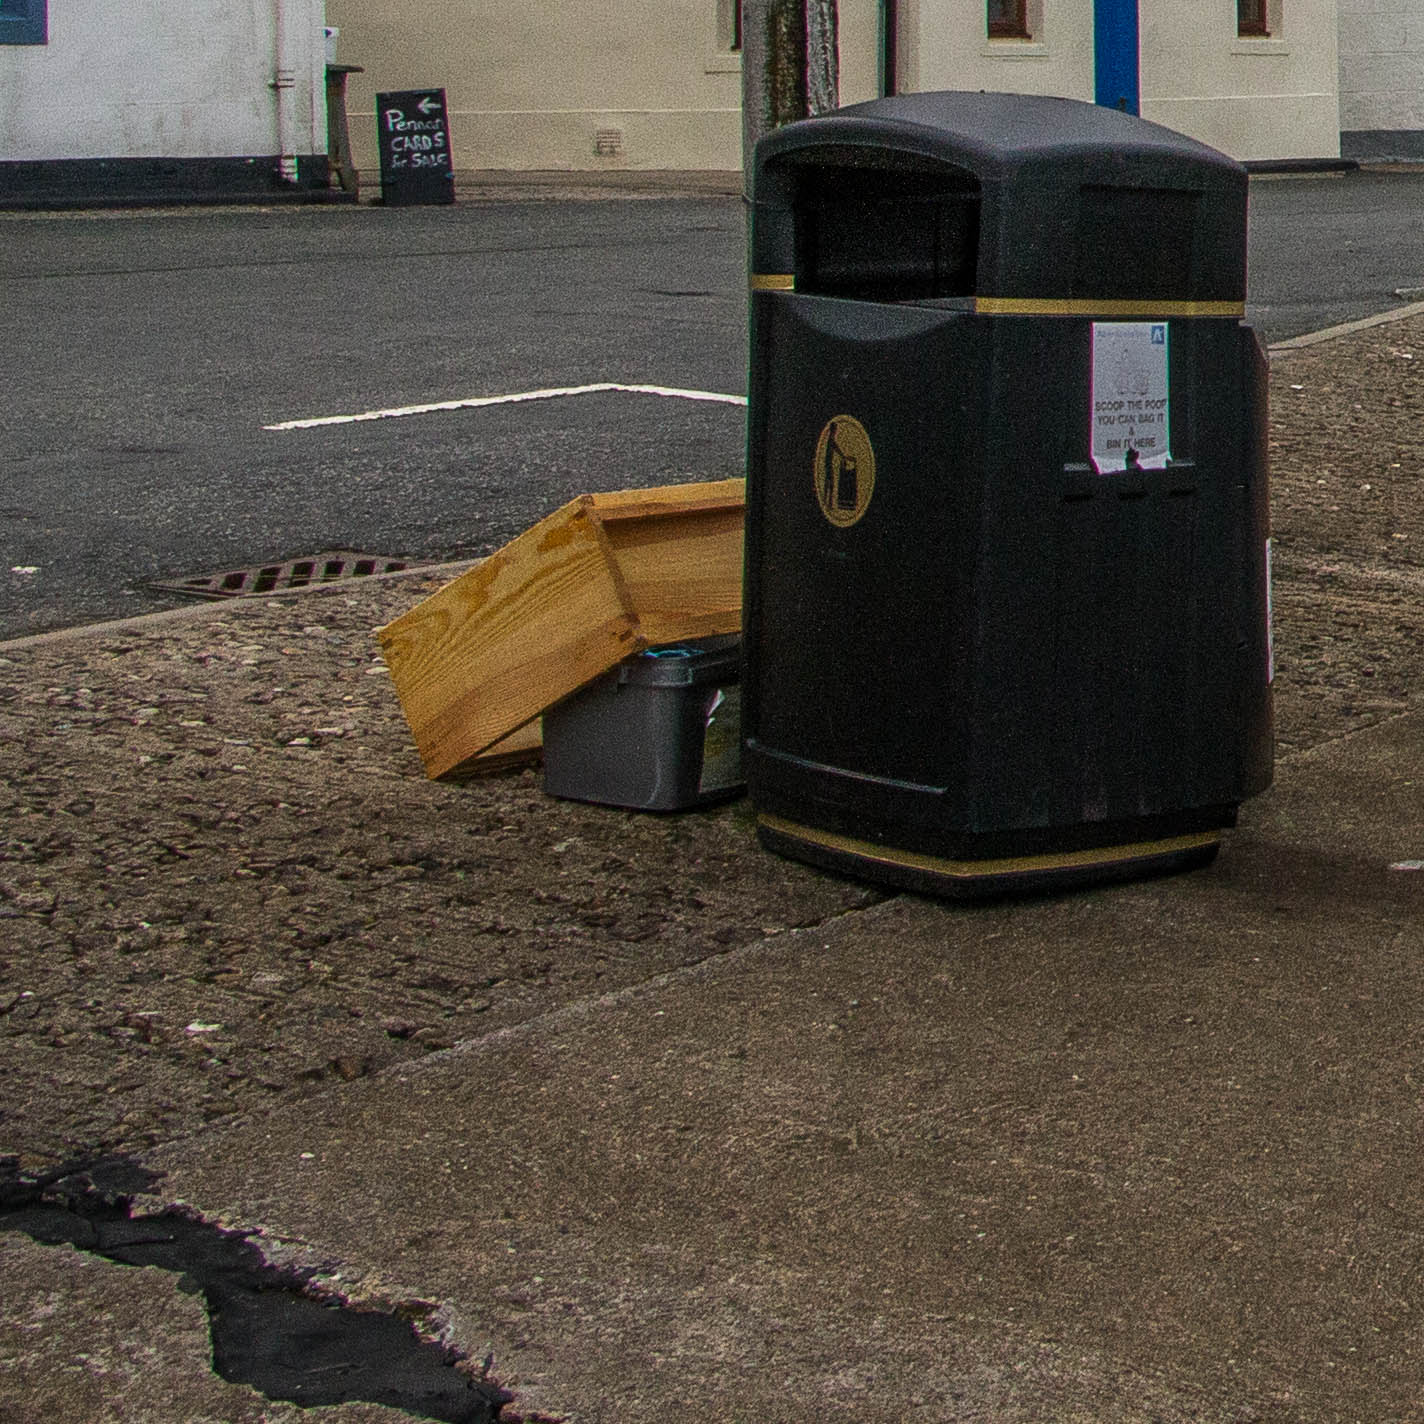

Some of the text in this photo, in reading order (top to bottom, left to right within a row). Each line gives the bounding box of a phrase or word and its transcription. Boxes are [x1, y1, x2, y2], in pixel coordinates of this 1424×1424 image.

[391, 132, 445, 152] CARDS
[411, 153, 448, 168] SALE
[1095, 399, 1167, 412] SCOOP THE POOP
[1097, 413, 1164, 425] YOU CAN BAG IT
[1106, 438, 1156, 449] BIN IT HERE
